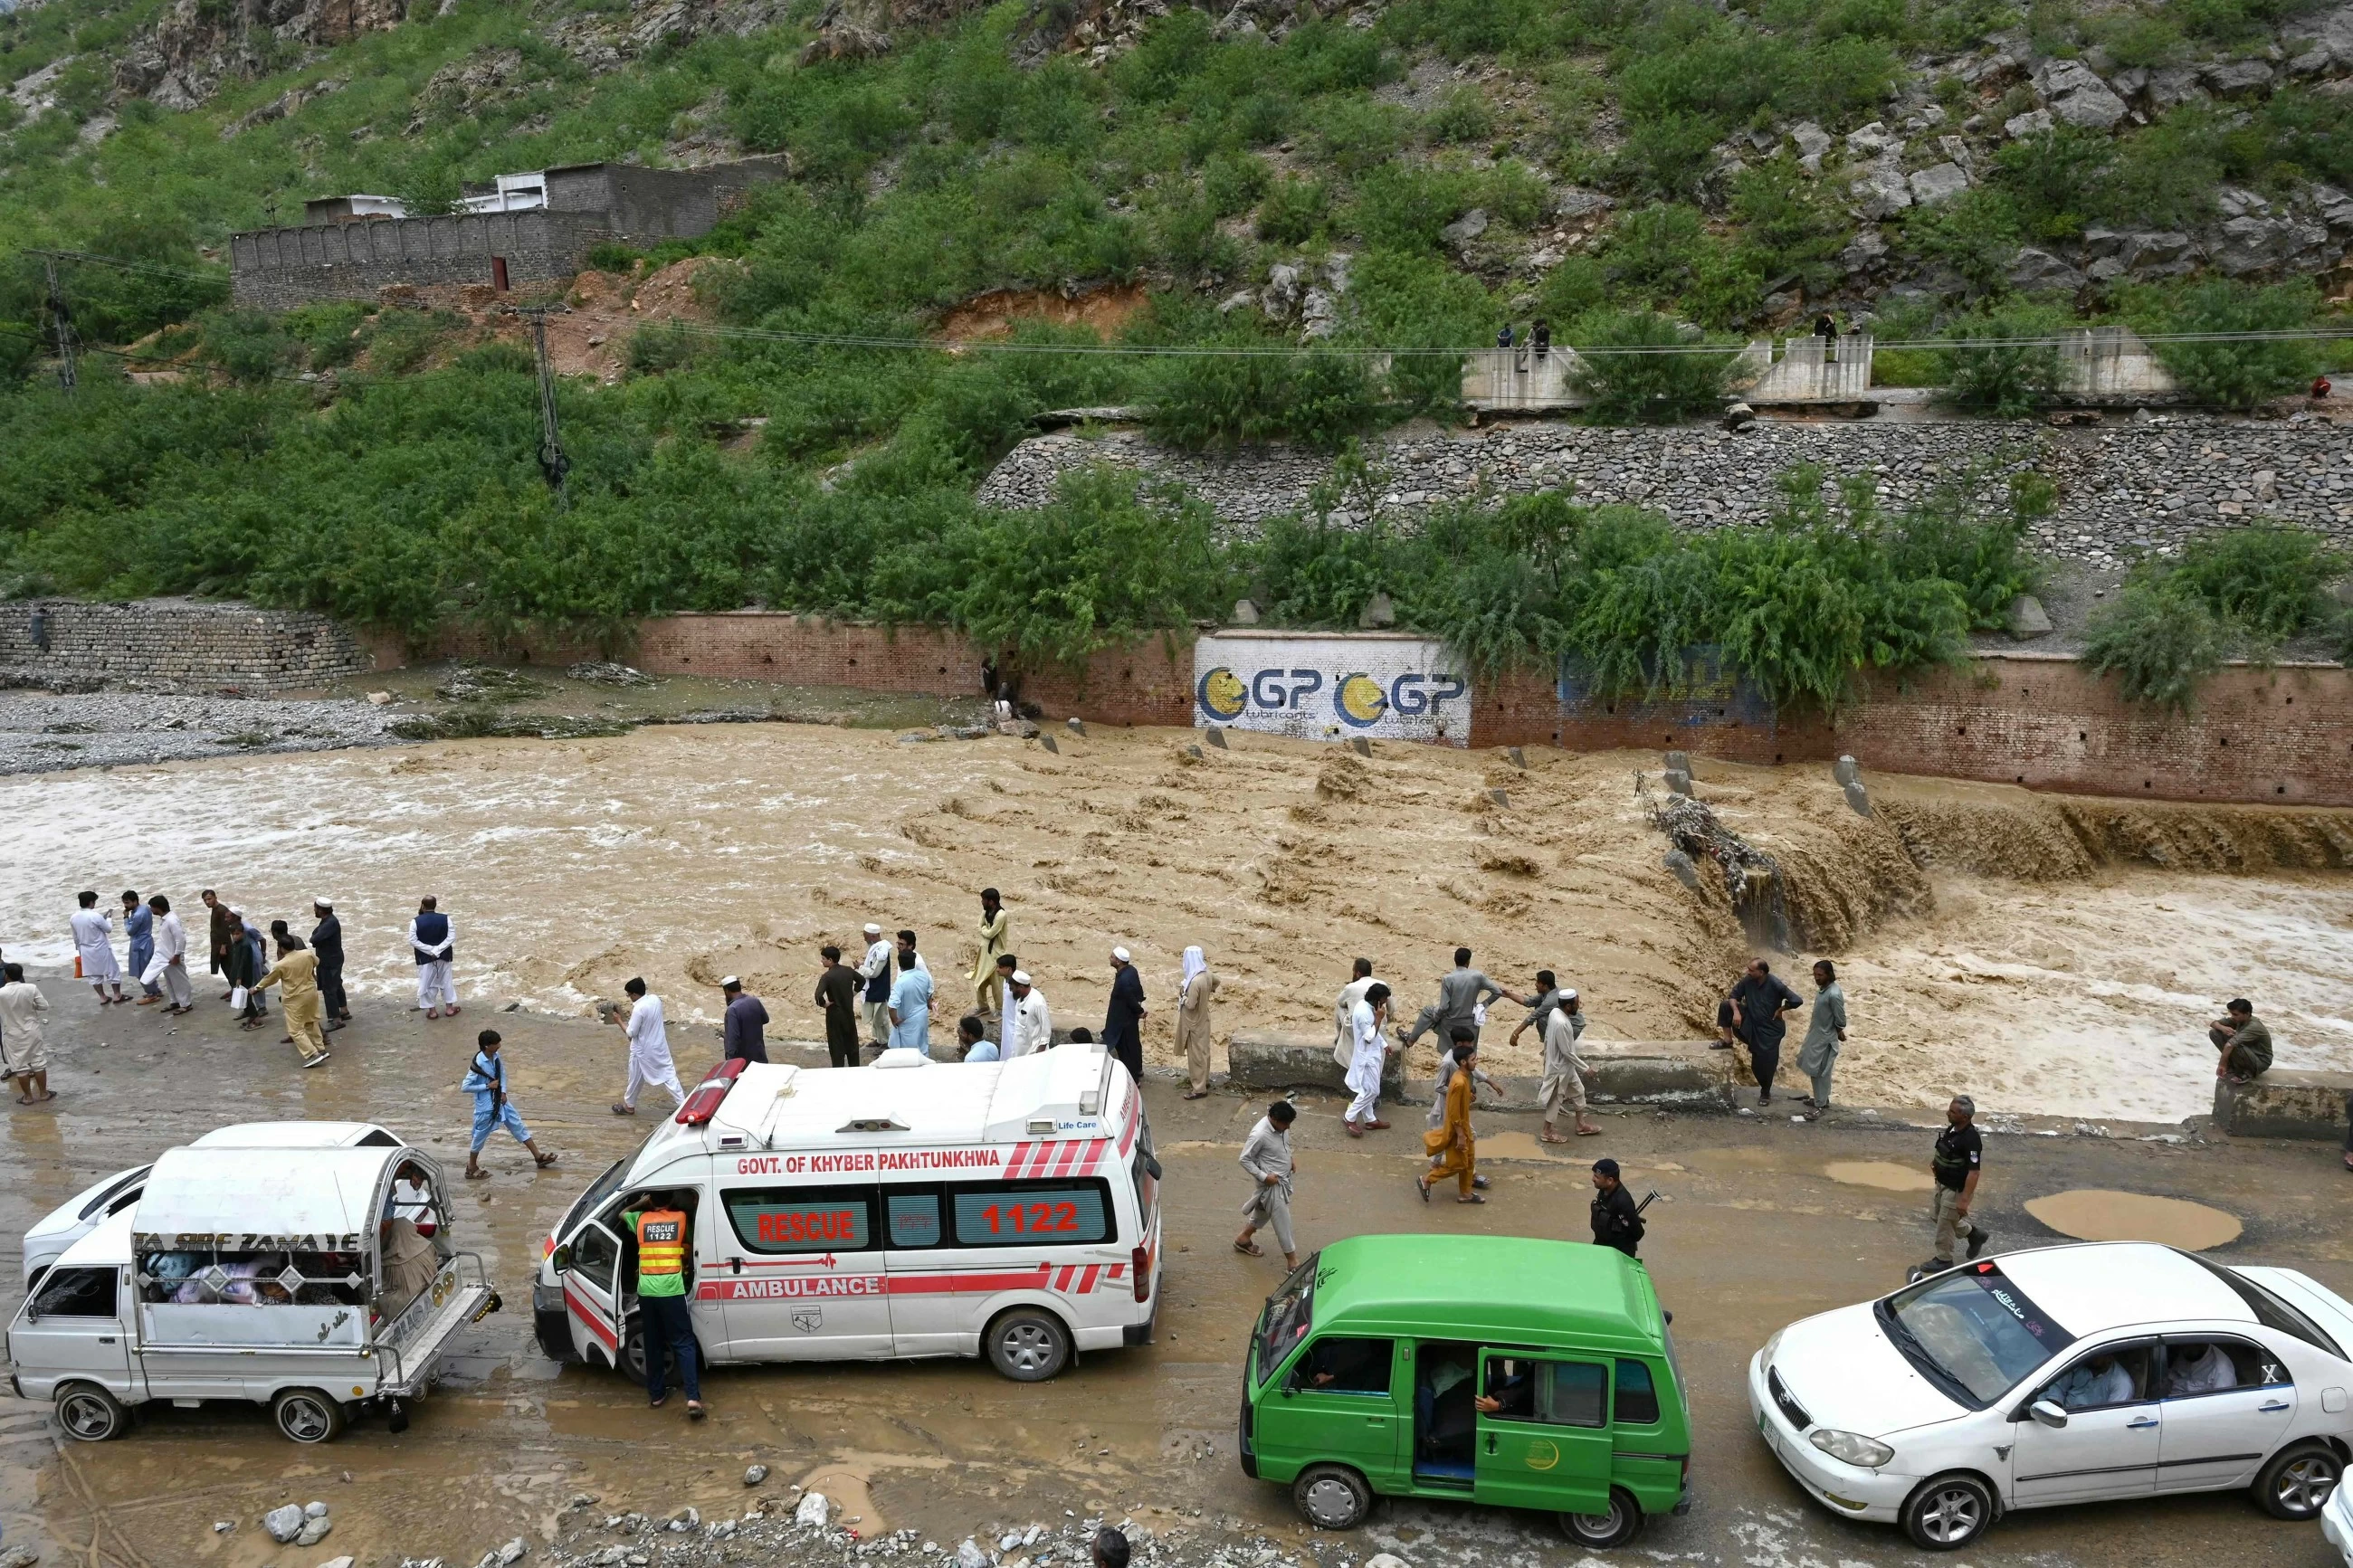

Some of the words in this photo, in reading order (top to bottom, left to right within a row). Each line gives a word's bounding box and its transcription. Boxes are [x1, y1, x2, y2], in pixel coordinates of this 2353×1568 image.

[1253, 669, 1322, 709] GP
[1391, 674, 1464, 715] GP
[1058, 1122, 1074, 1130] Life
[1076, 1121, 1097, 1129] Care
[738, 1157, 781, 1174] GOVT.
[786, 1156, 805, 1173] OF
[811, 1155, 874, 1173] KHYBER
[879, 1149, 1000, 1170] PAKHTUNKHWA
[757, 1211, 854, 1241] RESCUE
[982, 1202, 1079, 1234] 1122
[646, 1224, 675, 1233] RESCUE
[650, 1232, 672, 1240] 1122
[239, 1233, 319, 1252] ZAMA
[733, 1278, 880, 1298] AMBULANCE
[2262, 1364, 2279, 1383] X
